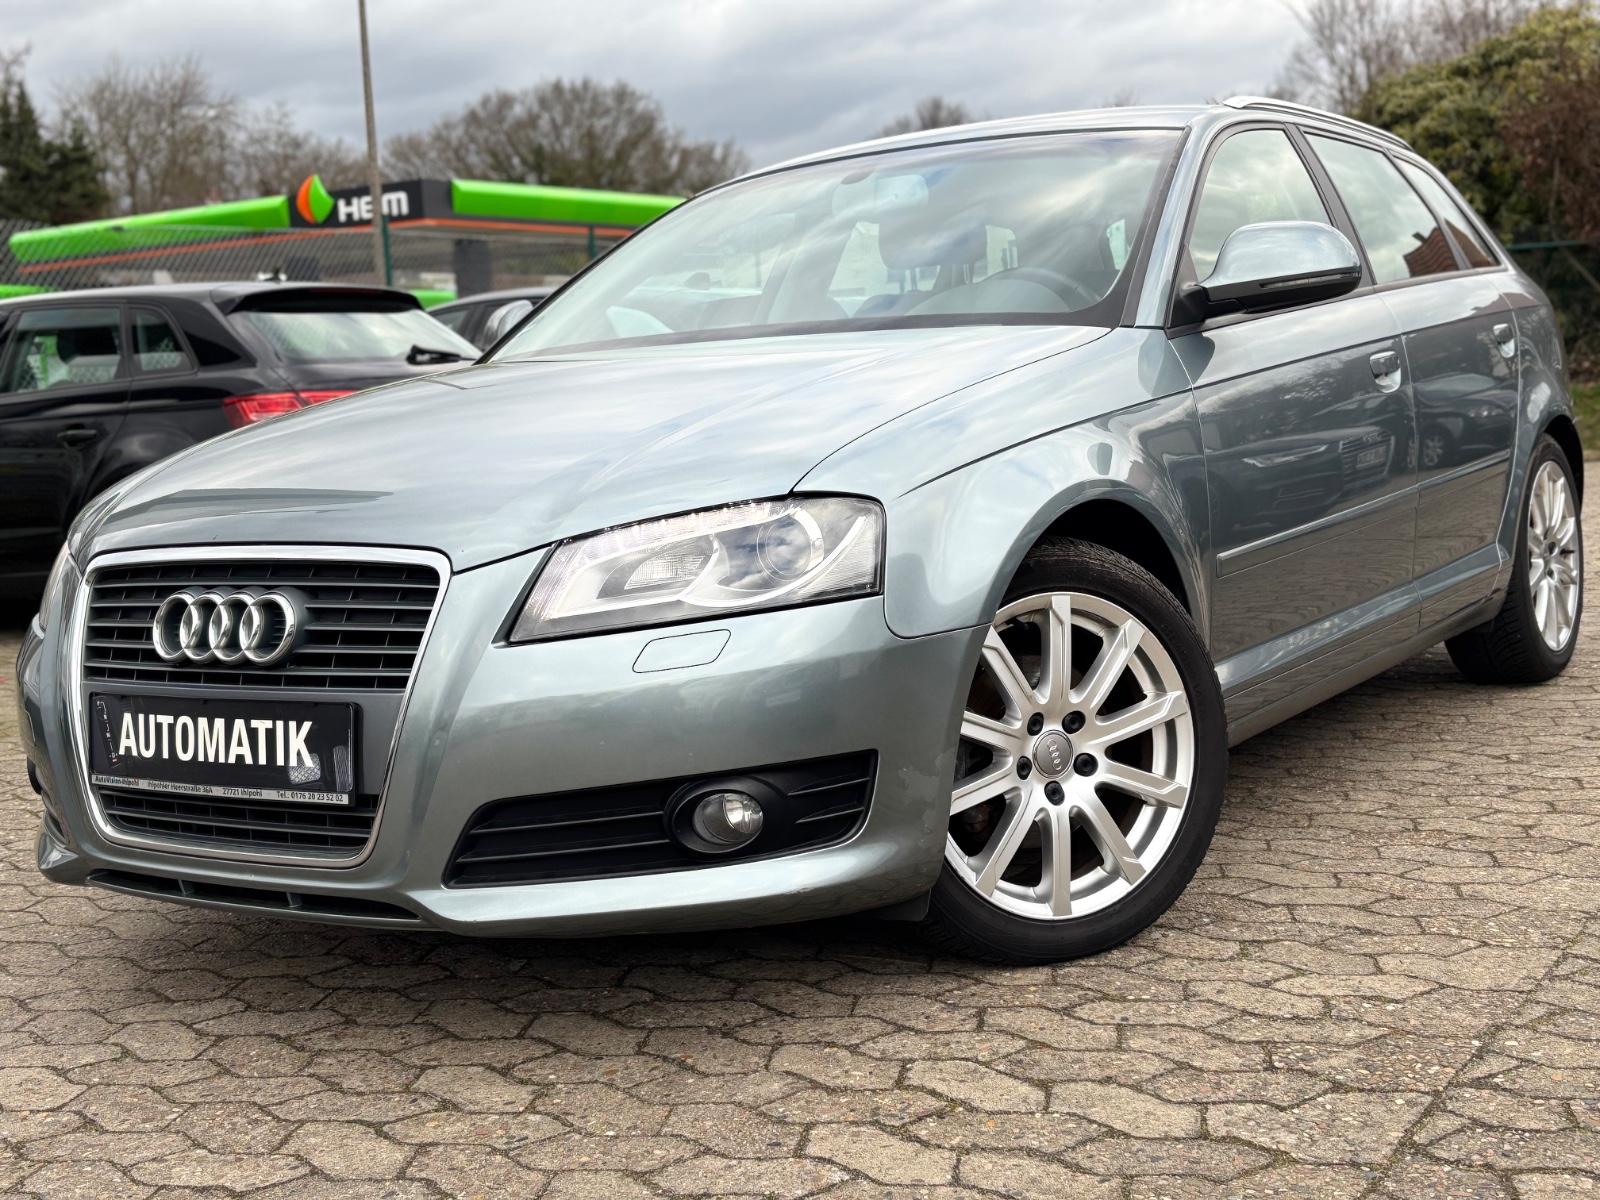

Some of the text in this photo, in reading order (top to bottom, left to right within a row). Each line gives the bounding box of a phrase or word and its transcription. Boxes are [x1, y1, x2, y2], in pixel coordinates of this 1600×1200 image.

[119, 712, 314, 767] AUTOMATIK
[202, 785, 213, 794] 36A
[223, 787, 239, 796] 27721
[277, 790, 290, 799] Tel.:
[291, 791, 307, 800] 0176
[316, 793, 325, 801] 23
[325, 793, 334, 802] 52
[335, 794, 344, 802] 02
